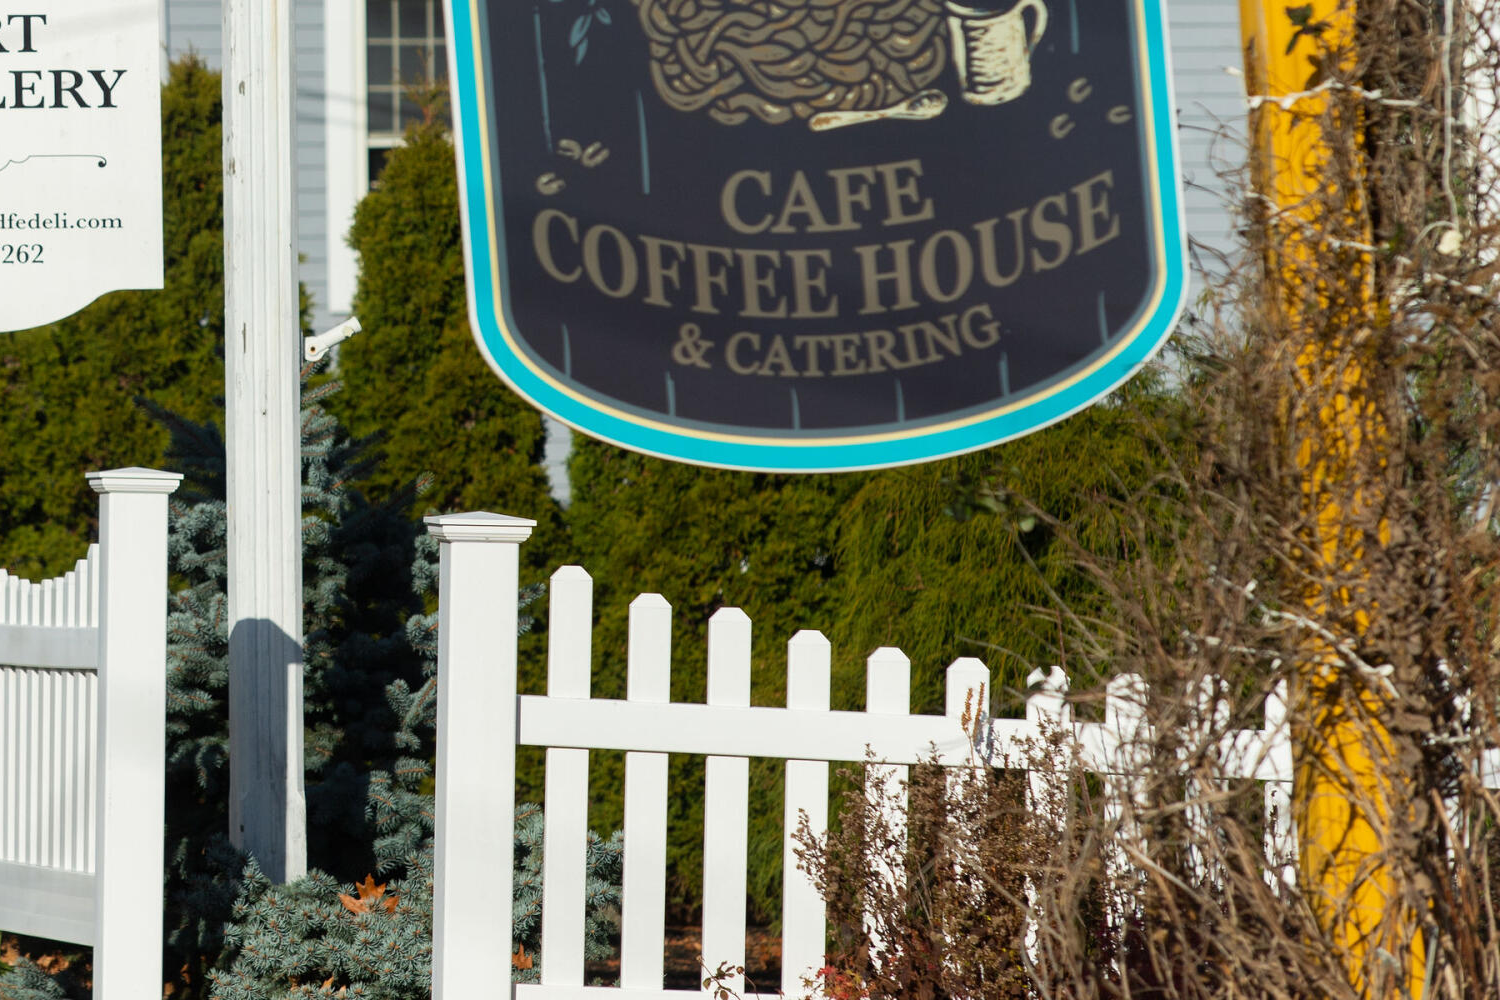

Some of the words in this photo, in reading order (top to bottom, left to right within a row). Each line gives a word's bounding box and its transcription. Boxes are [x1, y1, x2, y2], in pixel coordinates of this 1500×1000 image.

[720, 159, 935, 234] CAFE
[532, 208, 839, 319] COFFEE
[854, 170, 1122, 315] HOUSE
[672, 323, 714, 367] &
[724, 304, 1002, 377] CATERING
